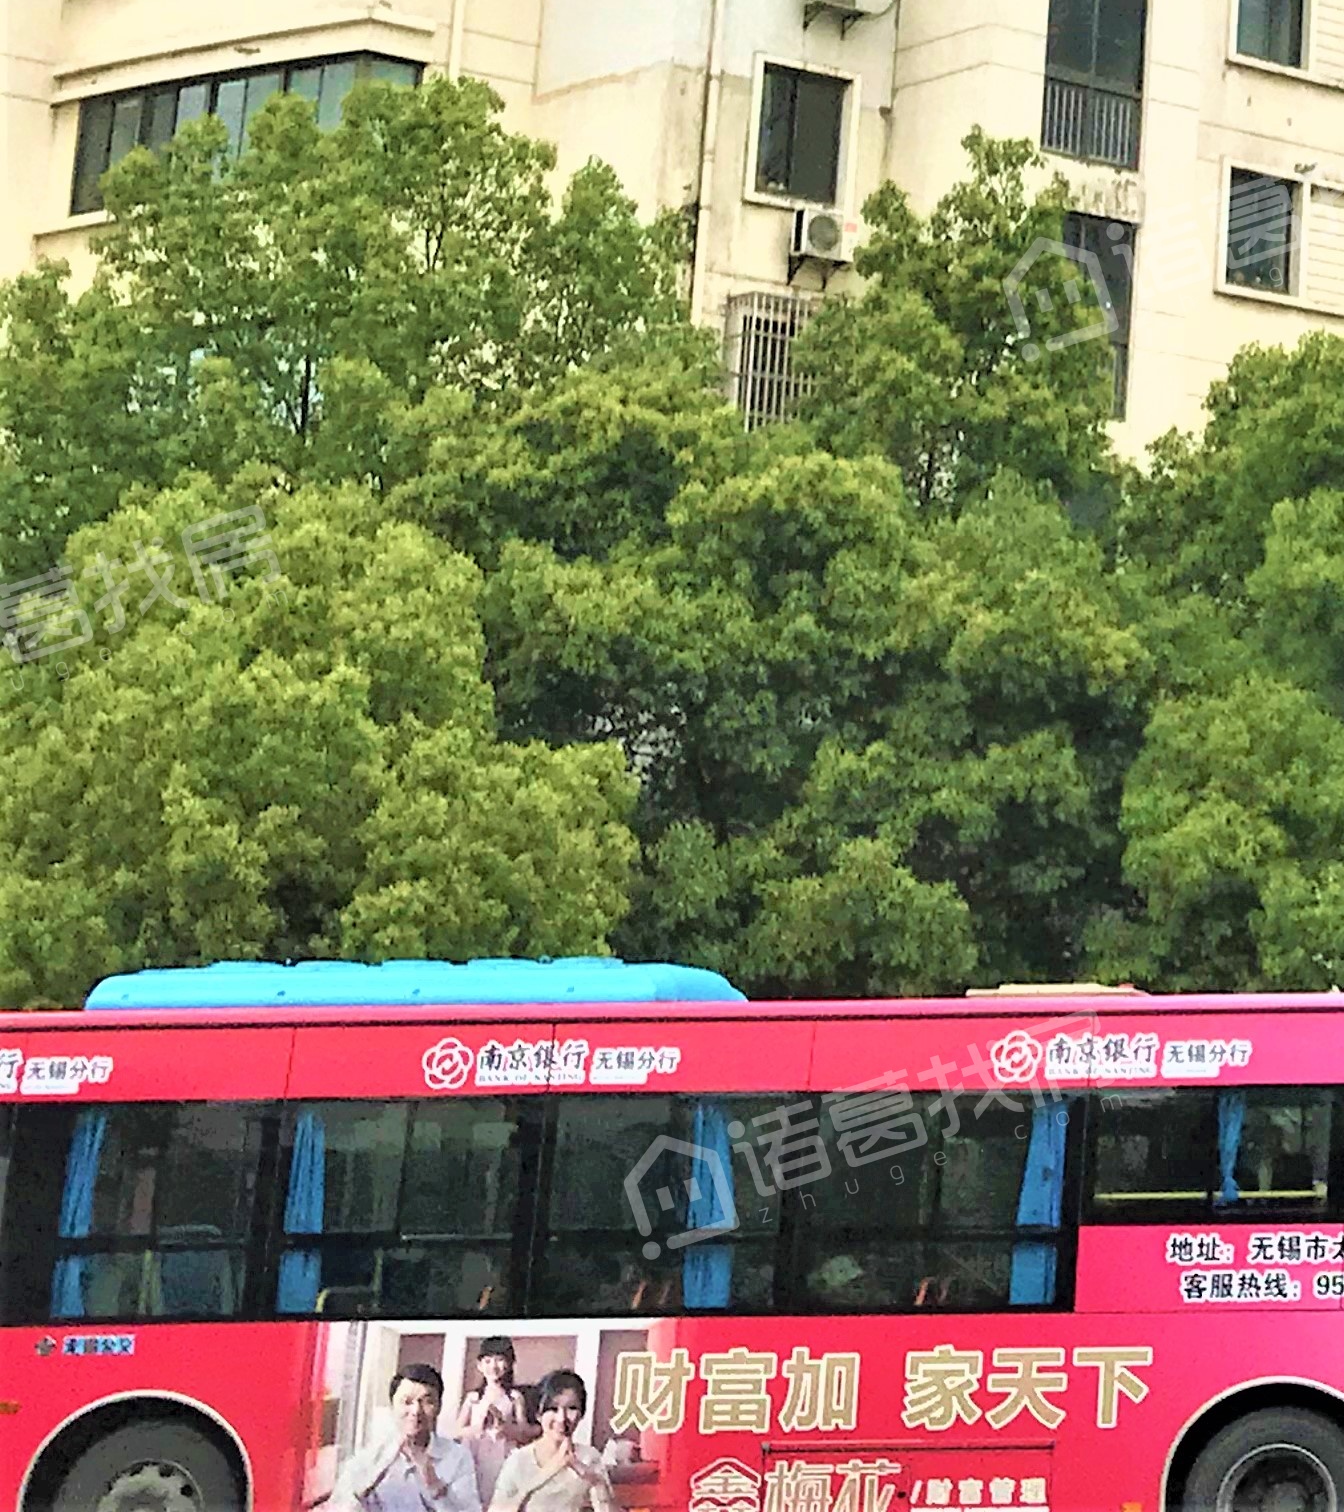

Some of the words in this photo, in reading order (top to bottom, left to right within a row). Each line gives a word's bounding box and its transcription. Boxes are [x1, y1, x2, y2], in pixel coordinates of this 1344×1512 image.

[479, 1043, 587, 1072] 南京银行
[595, 1050, 678, 1071] 无锡分行
[1049, 1036, 1157, 1064] 南京银行
[1166, 1043, 1250, 1064] 无锡分行
[611, 1348, 861, 1435] 财富加
[902, 1346, 1153, 1430] 家天下
